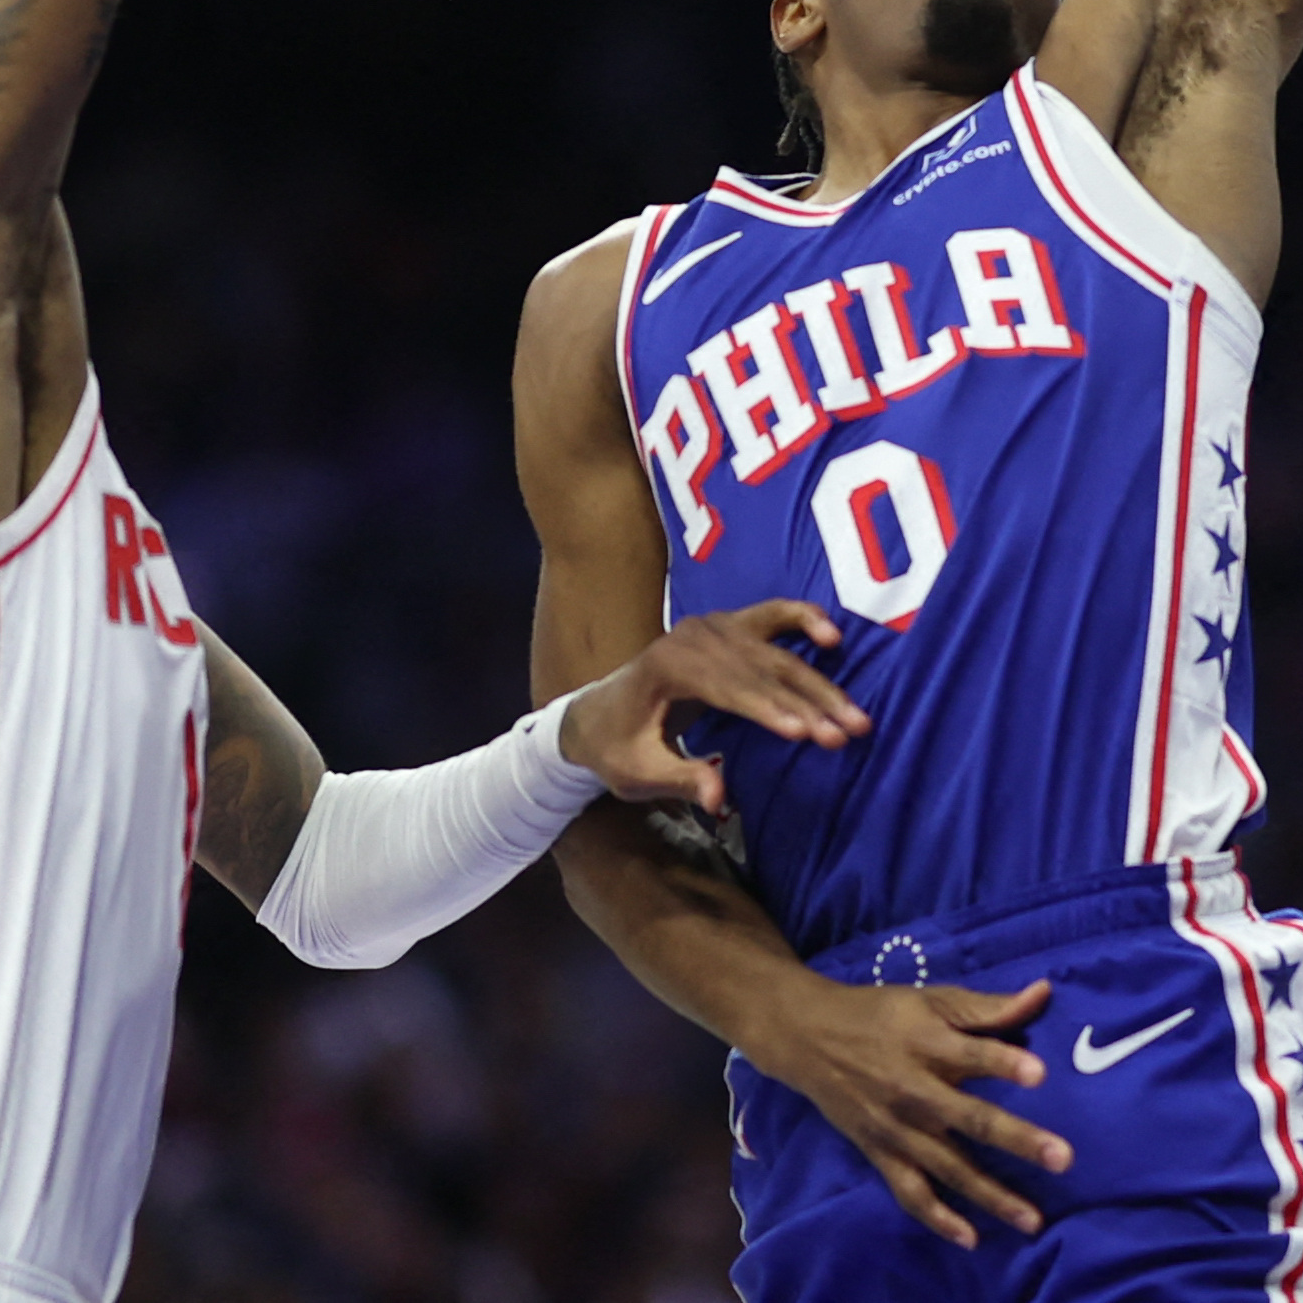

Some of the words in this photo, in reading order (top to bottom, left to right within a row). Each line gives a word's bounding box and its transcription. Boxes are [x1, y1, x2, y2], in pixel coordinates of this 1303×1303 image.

[892, 140, 1012, 206] crypto.com
[640, 227, 1086, 562] PHILA
[810, 439, 958, 633] 0
